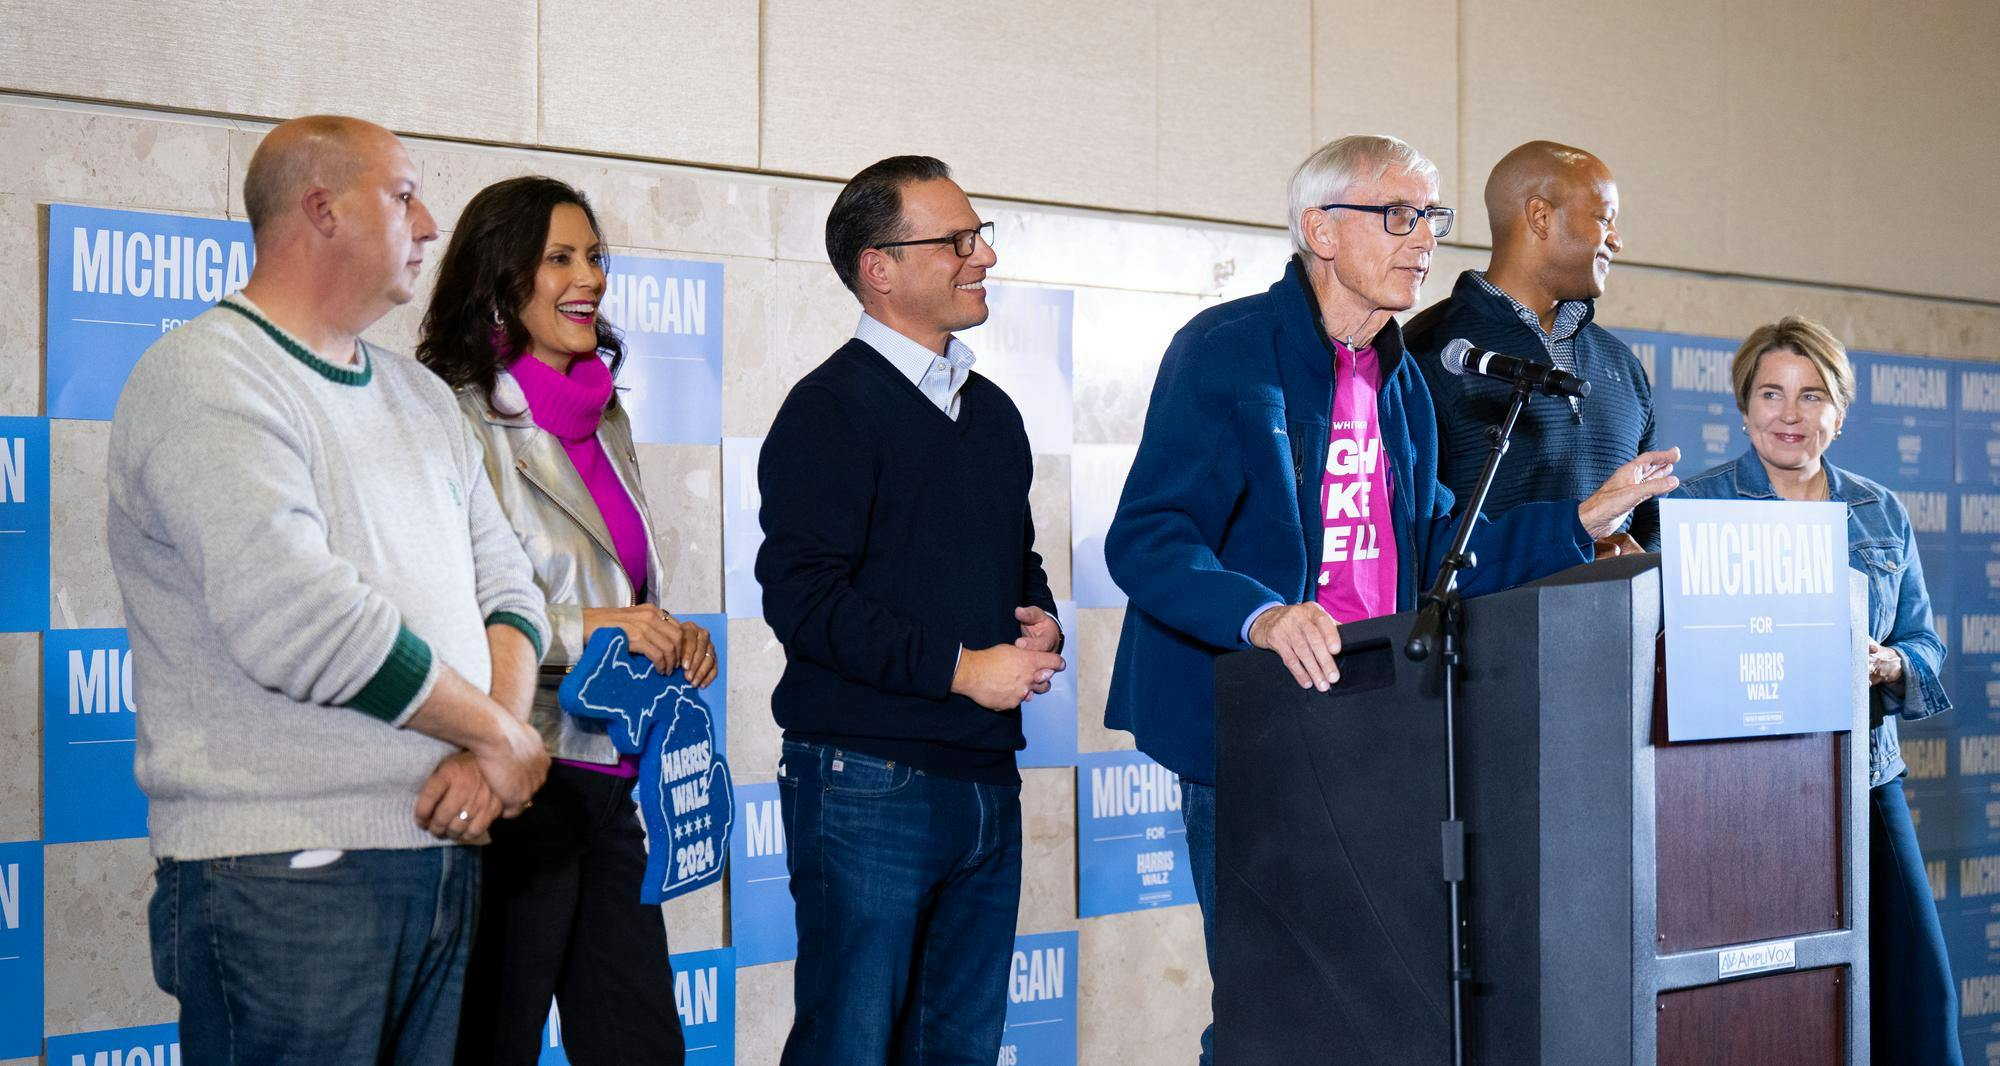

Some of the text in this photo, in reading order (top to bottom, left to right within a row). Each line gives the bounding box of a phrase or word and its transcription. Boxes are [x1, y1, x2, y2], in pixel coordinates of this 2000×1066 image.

[72, 226, 257, 303] MICHIGA
[606, 273, 706, 336] HIGAN
[1671, 346, 1734, 394] MICHIG
[1871, 363, 1948, 410] MICHIGAN
[1962, 371, 2000, 412] MICH
[1325, 437, 1380, 477] GH
[1320, 481, 1372, 520] KE
[1321, 523, 1380, 563] ELL
[1679, 521, 1834, 596] MICHIGAN
[1750, 616, 1773, 633] FOR
[1739, 651, 1785, 683] HARRIS
[1747, 683, 1779, 701] WALZ
[661, 740, 710, 784] HARRIS
[671, 776, 710, 817] WALZ
[1091, 763, 1182, 819] MICHIG
[1145, 826, 1166, 840] FOR
[676, 836, 714, 880] 2024
[1136, 850, 1175, 874] HARRIS
[1142, 872, 1169, 886] WALZ
